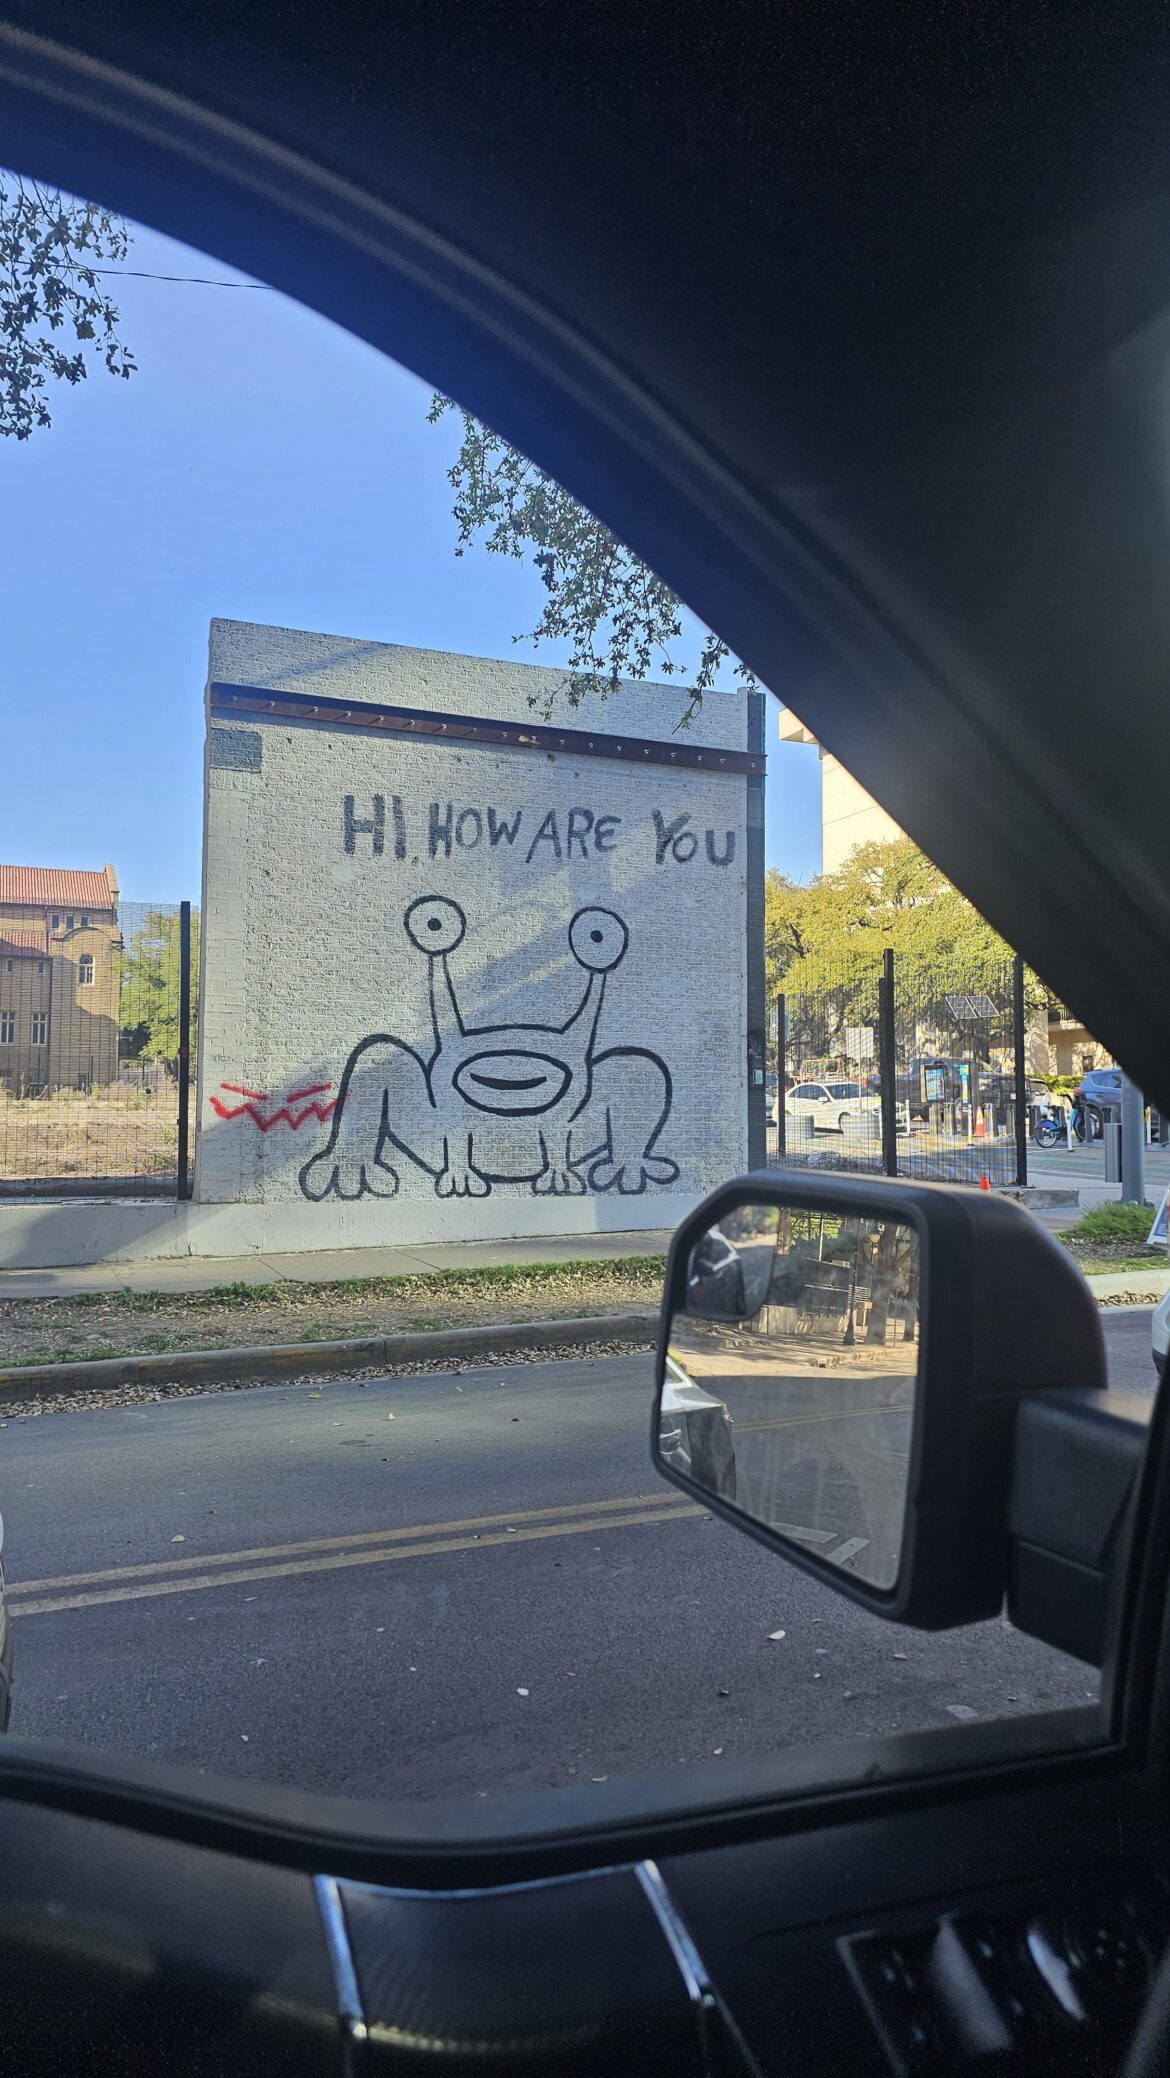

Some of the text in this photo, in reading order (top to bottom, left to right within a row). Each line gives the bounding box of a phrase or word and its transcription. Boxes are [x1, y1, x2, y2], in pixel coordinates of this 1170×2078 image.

[428, 802, 522, 859] HOW
[526, 806, 622, 863] ARE
[653, 808, 736, 866] YOU
